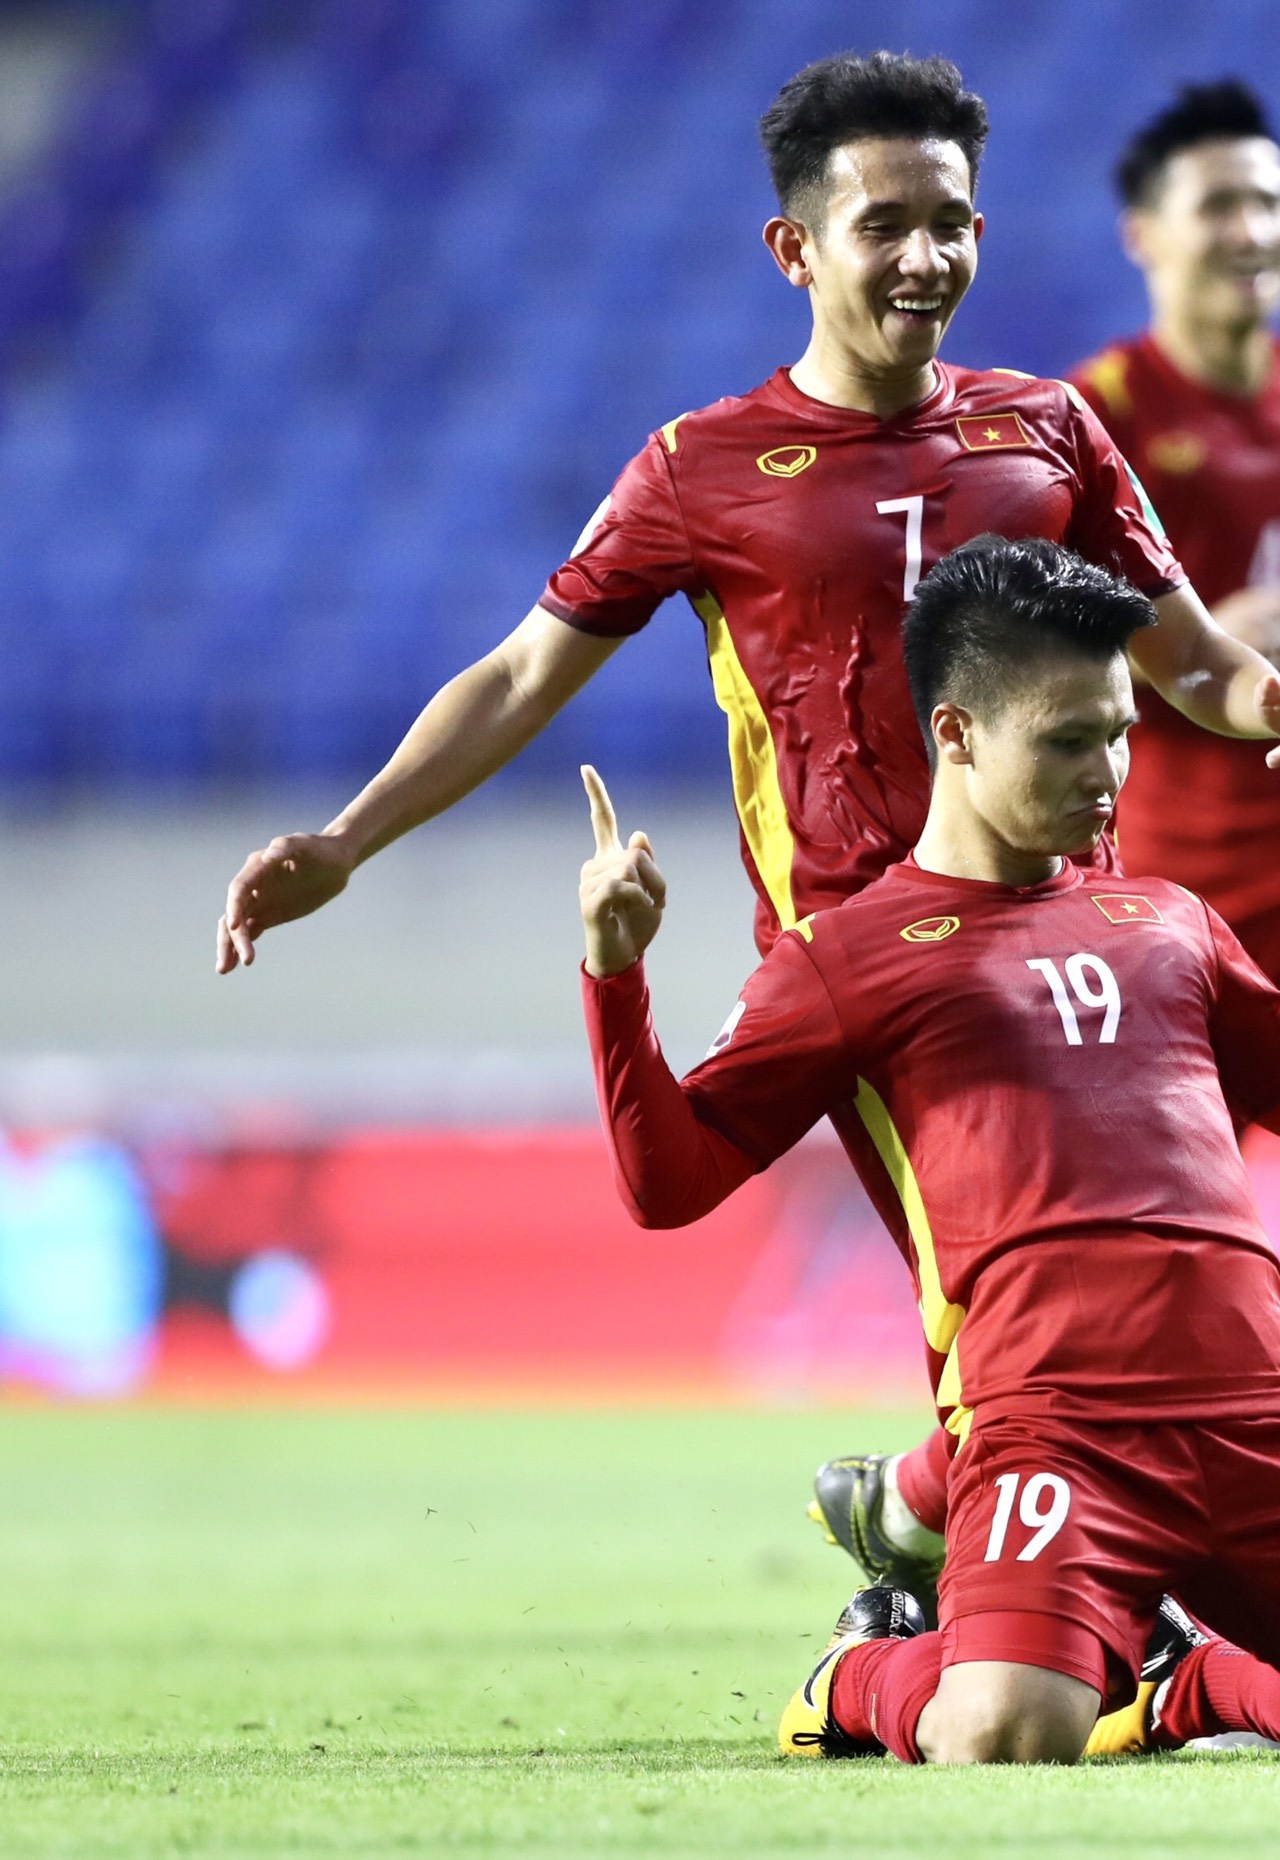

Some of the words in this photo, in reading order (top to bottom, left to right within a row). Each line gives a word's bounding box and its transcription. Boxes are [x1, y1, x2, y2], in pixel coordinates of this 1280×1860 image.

[876, 495, 924, 602] 7
[1026, 953, 1121, 1046] 19
[983, 1472, 1071, 1563] 19
